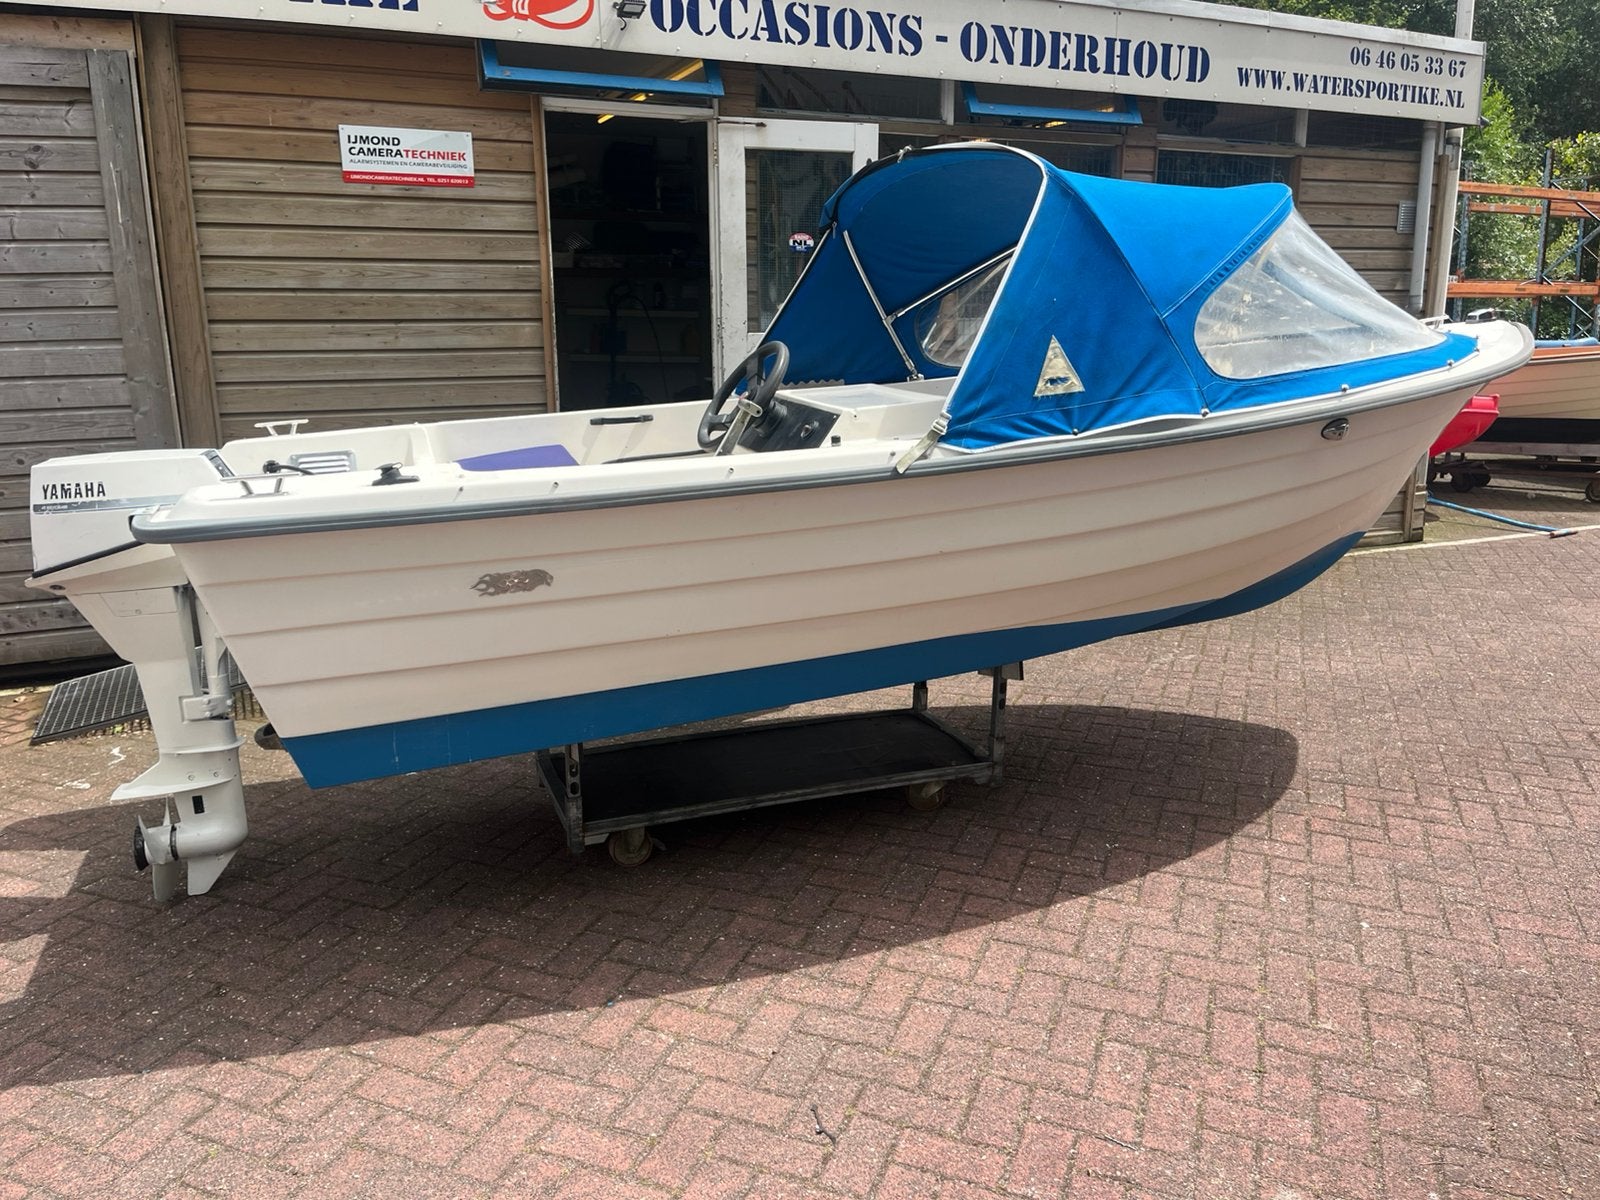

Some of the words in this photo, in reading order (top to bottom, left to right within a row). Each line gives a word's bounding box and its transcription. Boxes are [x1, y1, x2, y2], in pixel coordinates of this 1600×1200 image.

[650, 0, 923, 56] OCCASIONS
[960, 21, 1210, 83] ONDERHOUD
[1350, 46, 1371, 67] 06
[1375, 49, 1396, 70] 46
[1400, 52, 1420, 73] 05
[1425, 55, 1444, 76] 33
[1449, 59, 1467, 78] 67
[1237, 66, 1465, 109] WWW.WATERSPORTIKE.NL
[347, 134, 401, 147] IJMOND
[348, 146, 466, 161] CAMERATECHNIEK
[42, 481, 106, 500] YAMAHA
